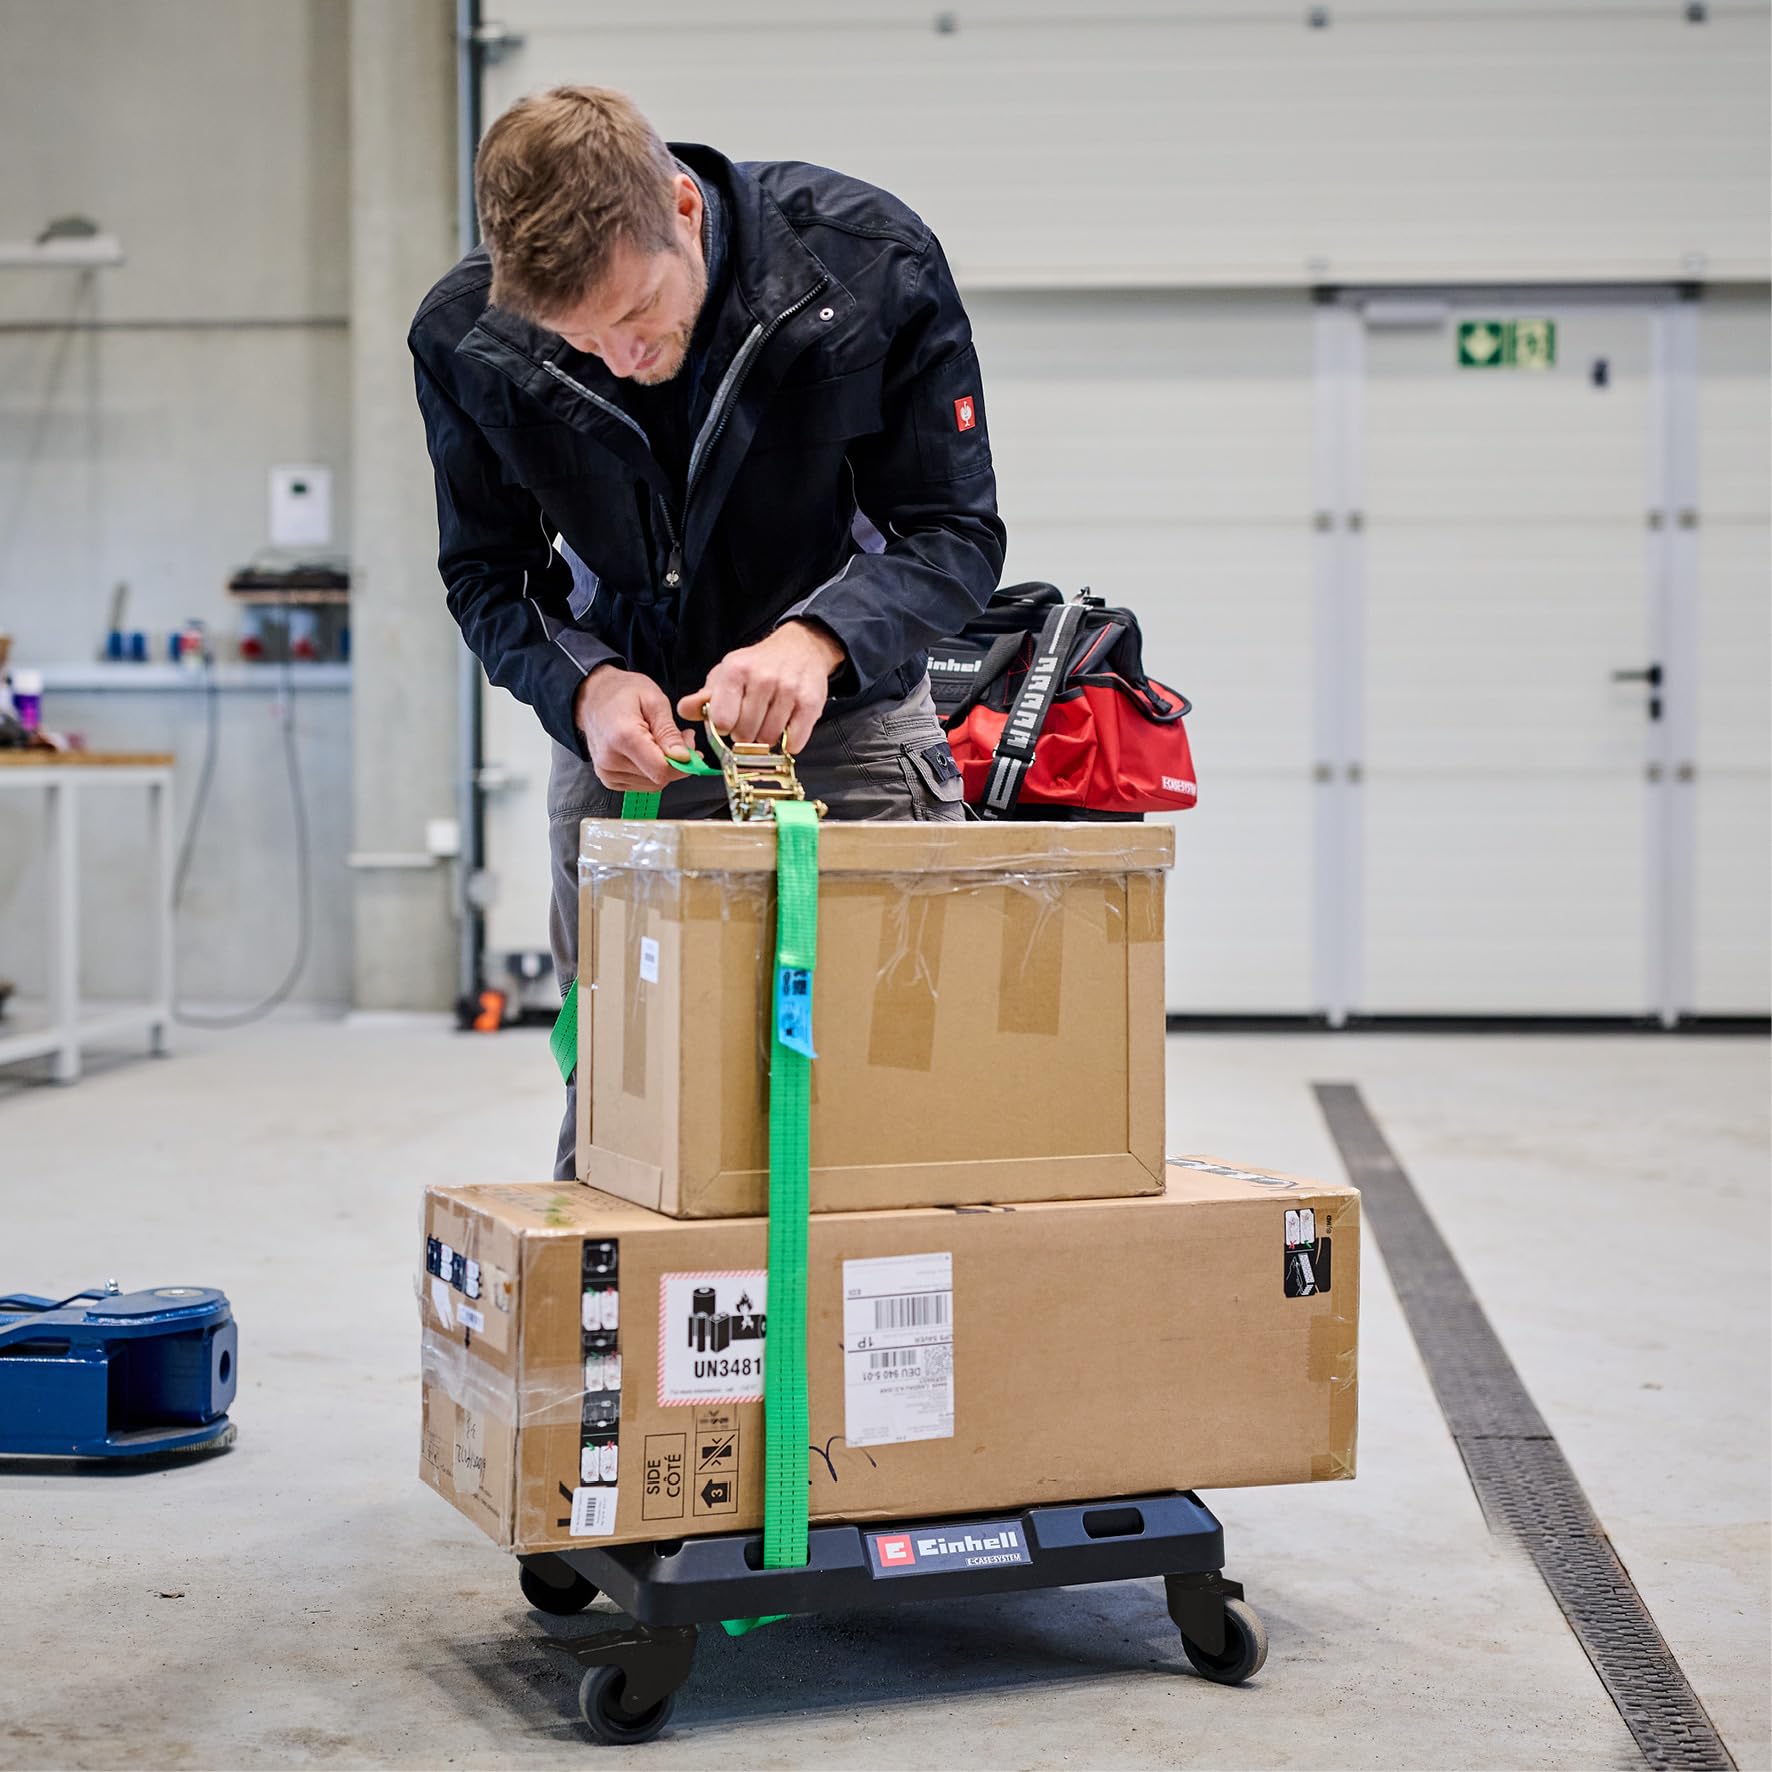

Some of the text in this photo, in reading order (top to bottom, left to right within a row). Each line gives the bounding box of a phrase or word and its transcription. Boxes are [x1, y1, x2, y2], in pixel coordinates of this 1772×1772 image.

[857, 1336, 874, 1349] 1P
[694, 1358, 761, 1378] UN3481
[863, 1371, 880, 1381] 5-01
[901, 1367, 921, 1377] DEU
[646, 1460, 661, 1495] SIDE
[664, 1454, 681, 1498] CÔTÉ
[917, 1531, 1018, 1556] Einhell
